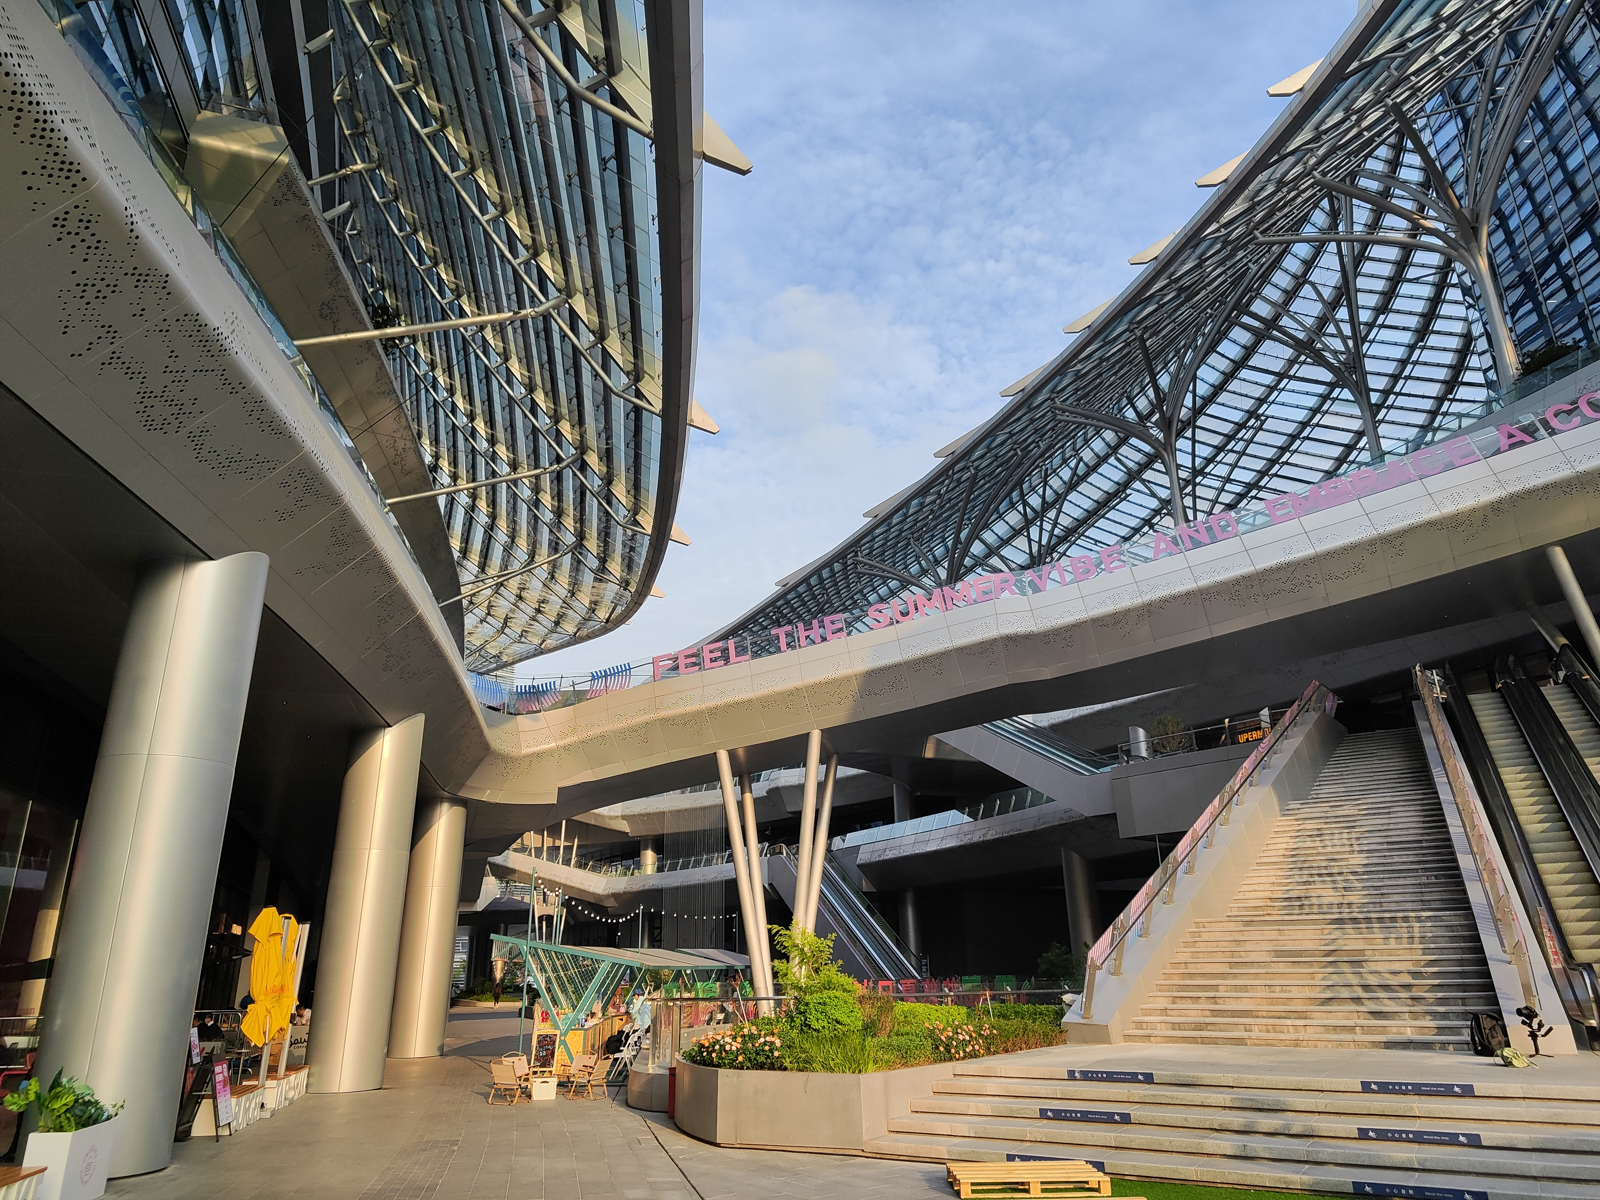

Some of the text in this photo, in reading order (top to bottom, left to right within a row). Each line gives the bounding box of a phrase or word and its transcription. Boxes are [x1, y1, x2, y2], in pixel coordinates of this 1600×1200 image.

[653, 639, 750, 681] FEEL
[771, 613, 846, 652] THE
[867, 571, 1018, 630] SUMMER
[1027, 545, 1127, 592] VIBE
[1152, 512, 1239, 560] AND
[1263, 435, 1482, 524] EMBRACE
[1498, 423, 1536, 452] A
